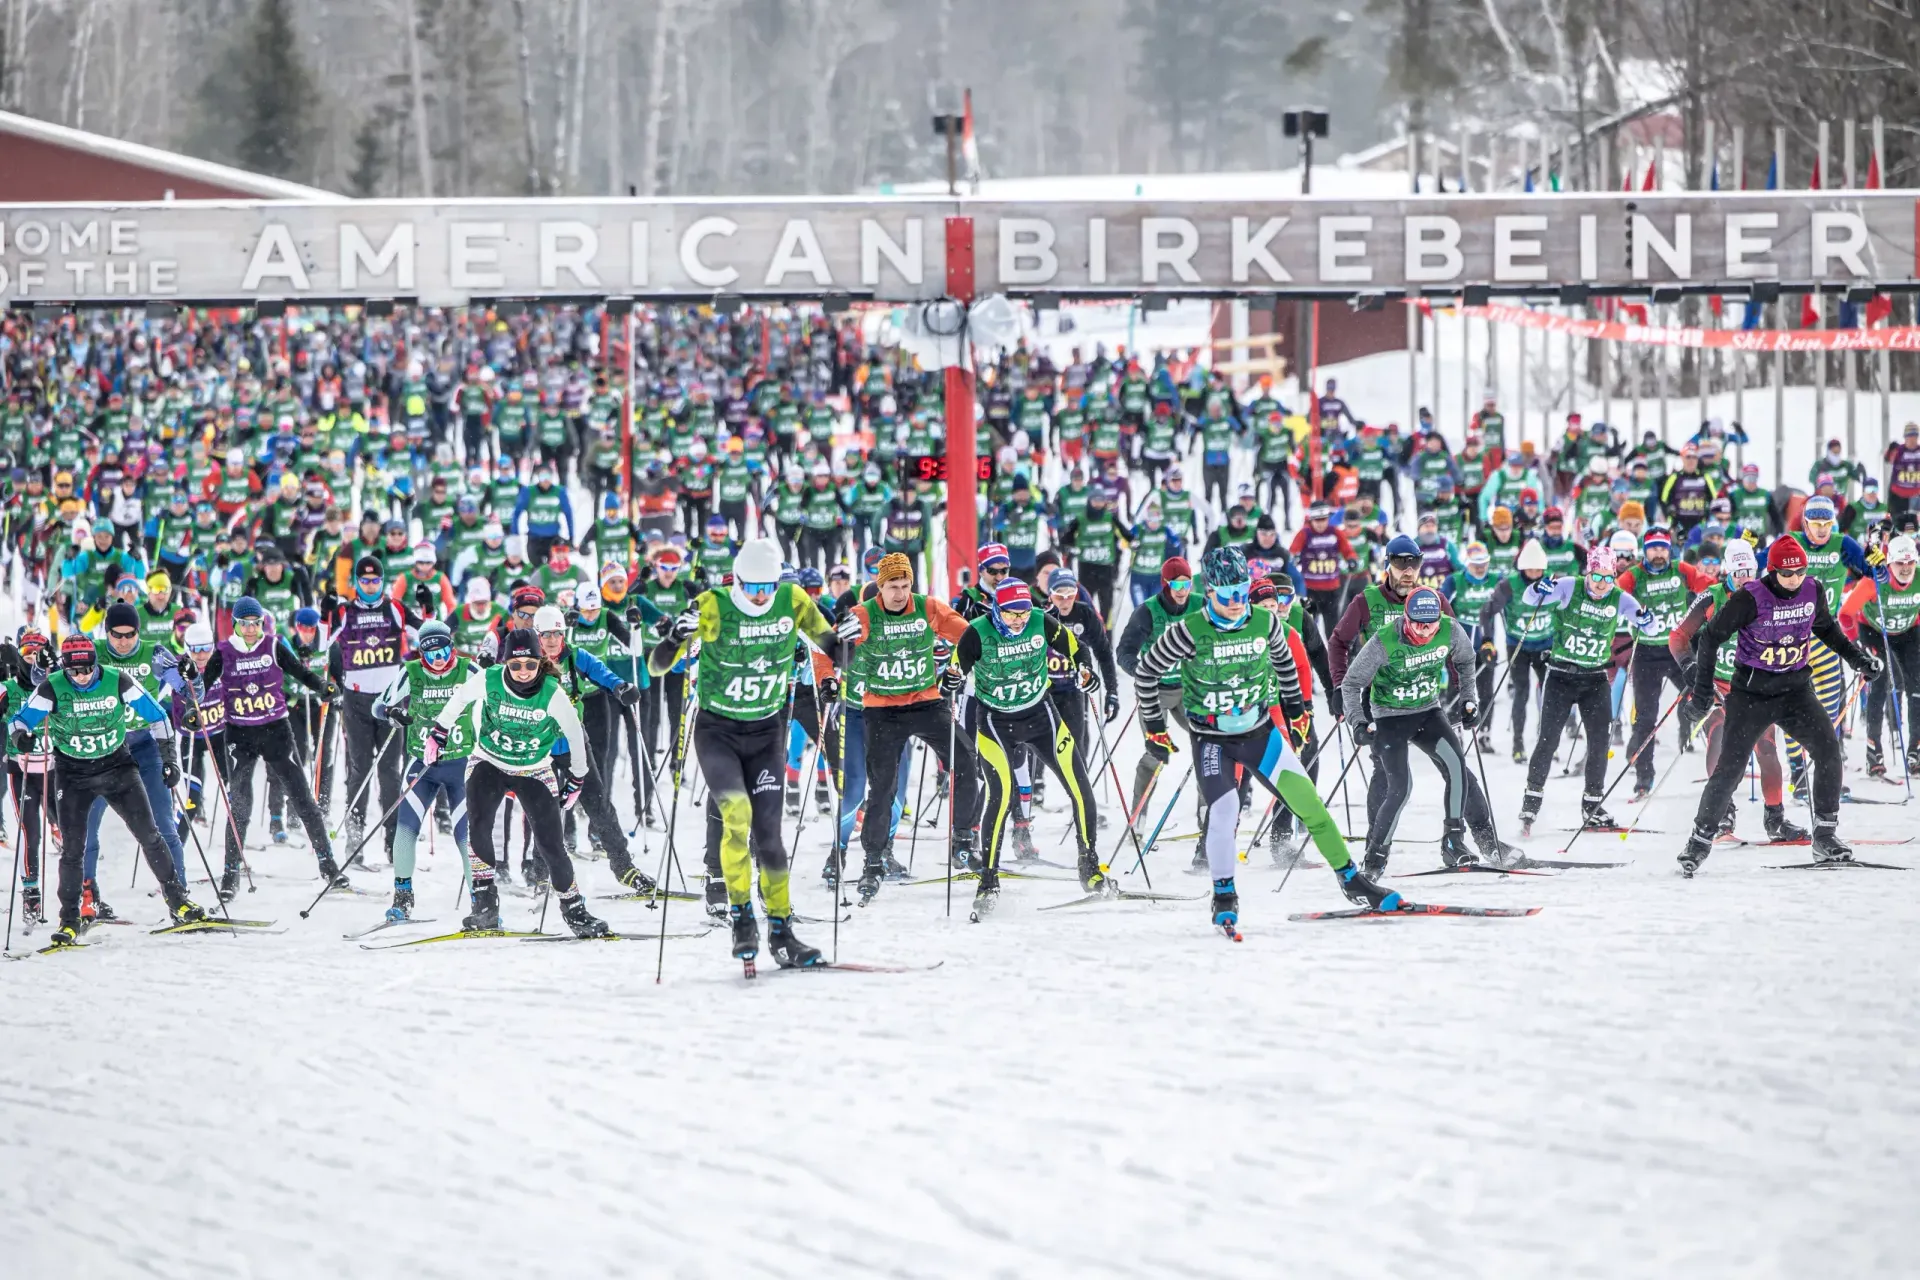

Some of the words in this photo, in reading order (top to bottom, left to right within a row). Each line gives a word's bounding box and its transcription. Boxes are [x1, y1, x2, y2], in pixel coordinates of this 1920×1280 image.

[0, 220, 139, 255] OME
[242, 217, 923, 290] AMERICAN
[999, 212, 1870, 284] BIRKEBEINER
[0, 262, 47, 296] F
[66, 261, 178, 294] THE
[1772, 607, 1804, 620] BIRKIE
[740, 624, 780, 638] BIRKIE
[884, 623, 916, 636] BIRKIE
[998, 642, 1032, 658] BIRKIE
[1214, 643, 1253, 658] BIRKIE
[1564, 634, 1608, 658] 4527
[352, 647, 394, 666] 4012
[1405, 652, 1438, 668] BIRKIE
[236, 661, 262, 672] BIRKIE
[877, 656, 927, 681] 4456
[422, 689, 454, 699] BIRKIE
[725, 671, 787, 702] 4571
[73, 700, 106, 712] BIRKIE
[234, 692, 276, 716] 4140
[498, 704, 533, 720] BIRKIE
[70, 729, 118, 754] 4312
[490, 730, 541, 752] 4333
[463, 931, 505, 939] FISCHER
